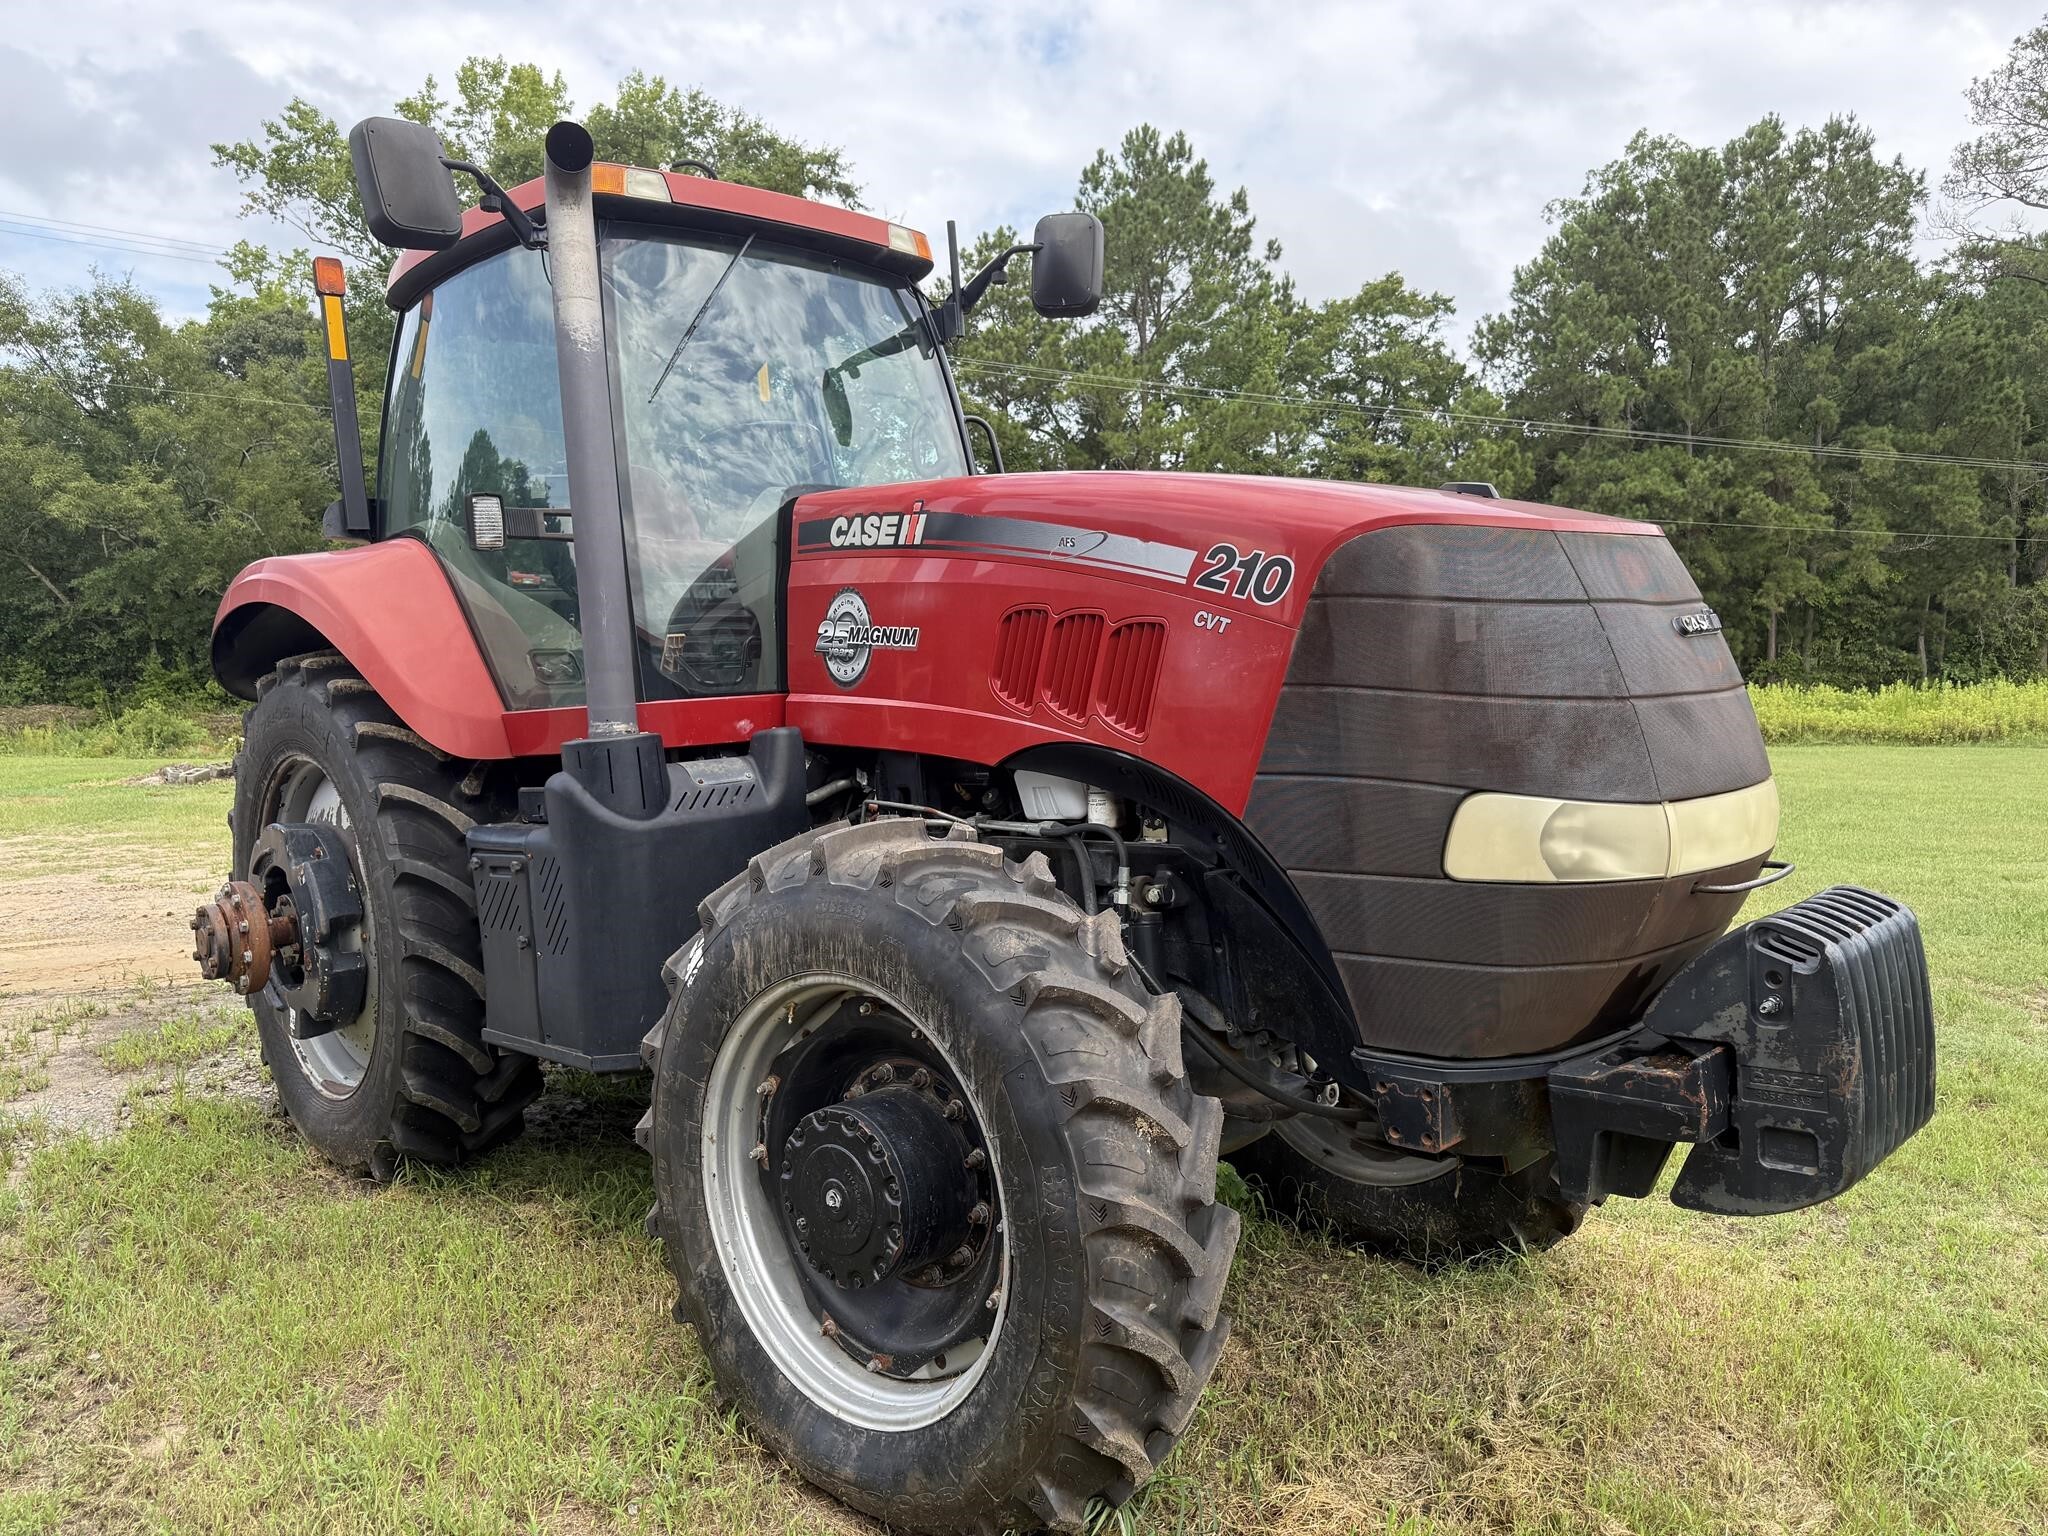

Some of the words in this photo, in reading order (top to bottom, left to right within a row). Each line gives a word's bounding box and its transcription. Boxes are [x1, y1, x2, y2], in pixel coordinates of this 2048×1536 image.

[829, 515, 899, 547] CASE
[1058, 537, 1076, 548] AFS
[1192, 542, 1296, 606] 210
[1193, 610, 1232, 634] CVT
[814, 620, 852, 652] 25
[846, 625, 920, 647] MAGNUM
[828, 647, 855, 660] years
